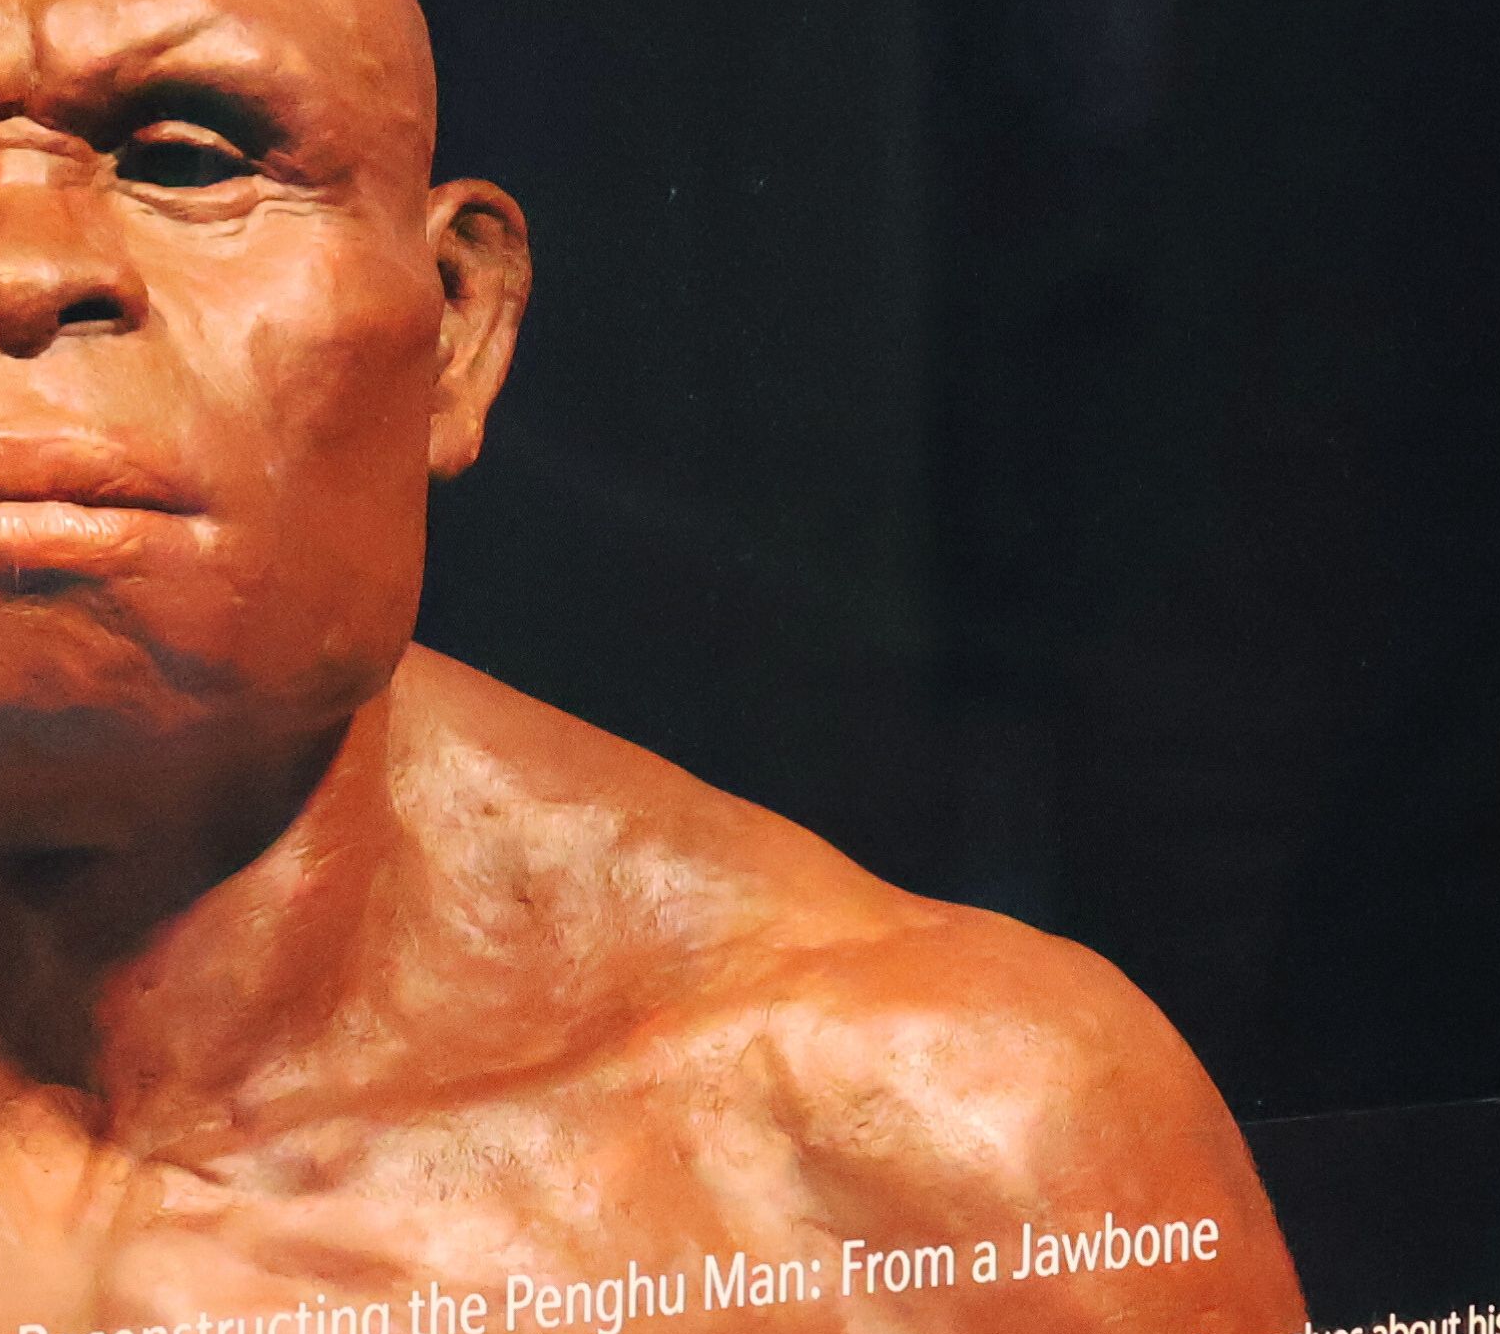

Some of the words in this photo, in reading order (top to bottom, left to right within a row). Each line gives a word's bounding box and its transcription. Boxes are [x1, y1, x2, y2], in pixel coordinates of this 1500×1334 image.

[704, 1251, 820, 1309] Man:
[842, 1239, 953, 1296] From
[972, 1240, 996, 1283] a
[1013, 1213, 1218, 1279] Jawbone
